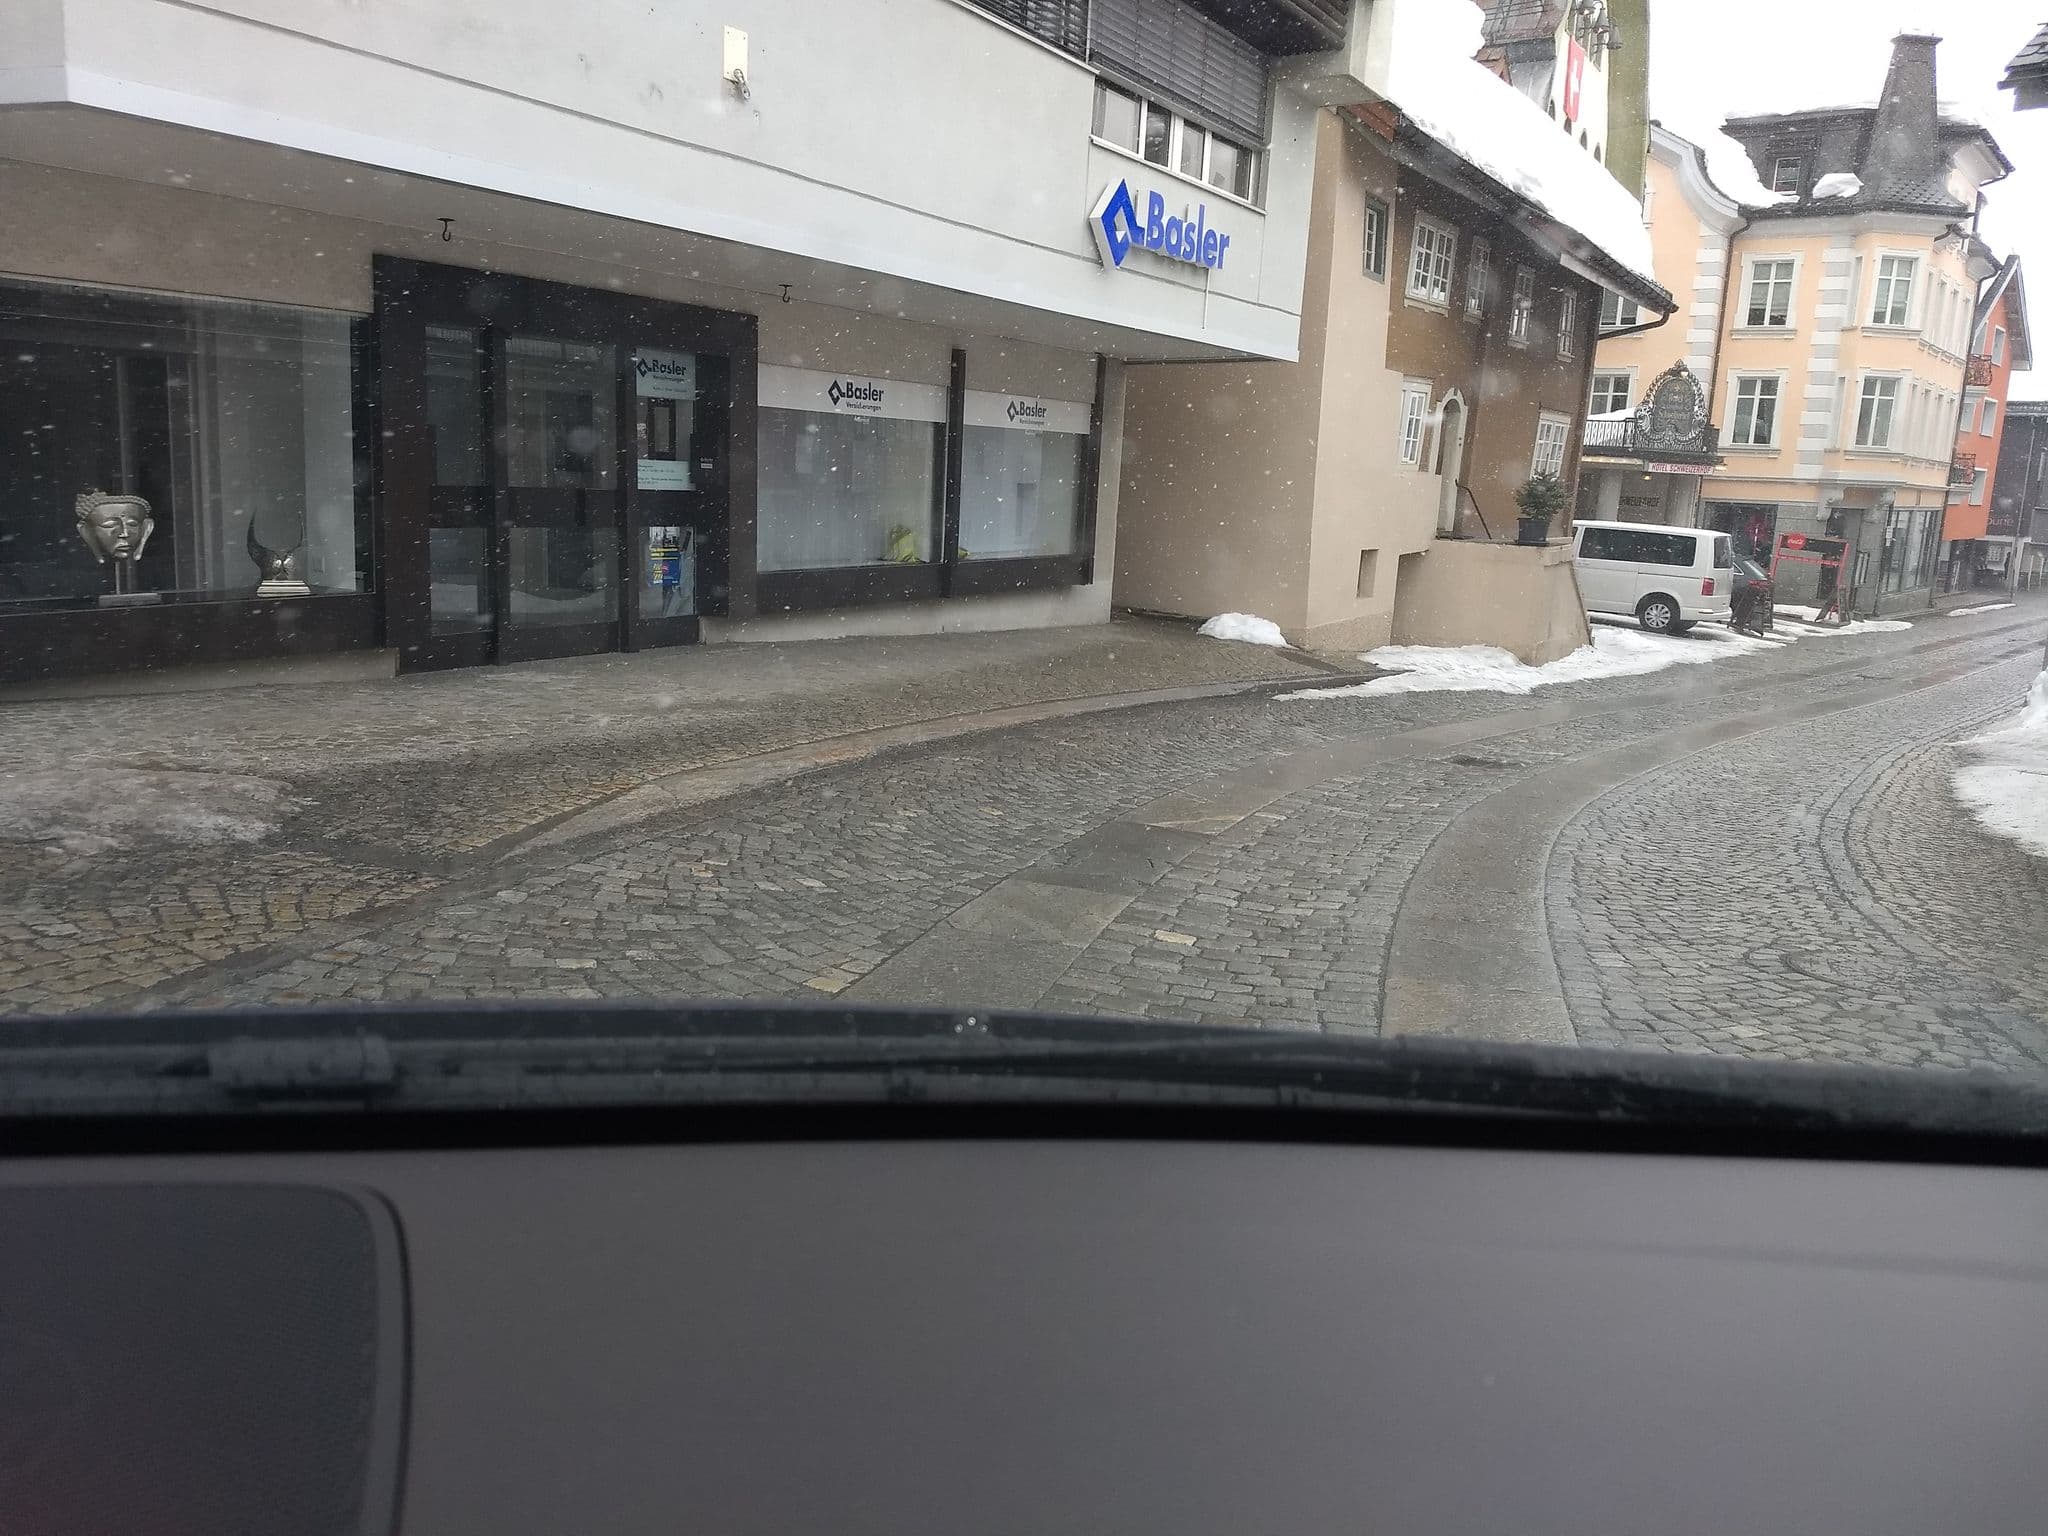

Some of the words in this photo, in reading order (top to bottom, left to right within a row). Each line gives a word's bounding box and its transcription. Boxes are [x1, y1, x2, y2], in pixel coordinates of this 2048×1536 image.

[1146, 190, 1230, 269] Basler
[652, 359, 687, 376] Basler
[846, 381, 884, 402] Basler
[1019, 400, 1047, 418] Basler
[1651, 463, 1669, 473] HOTEL
